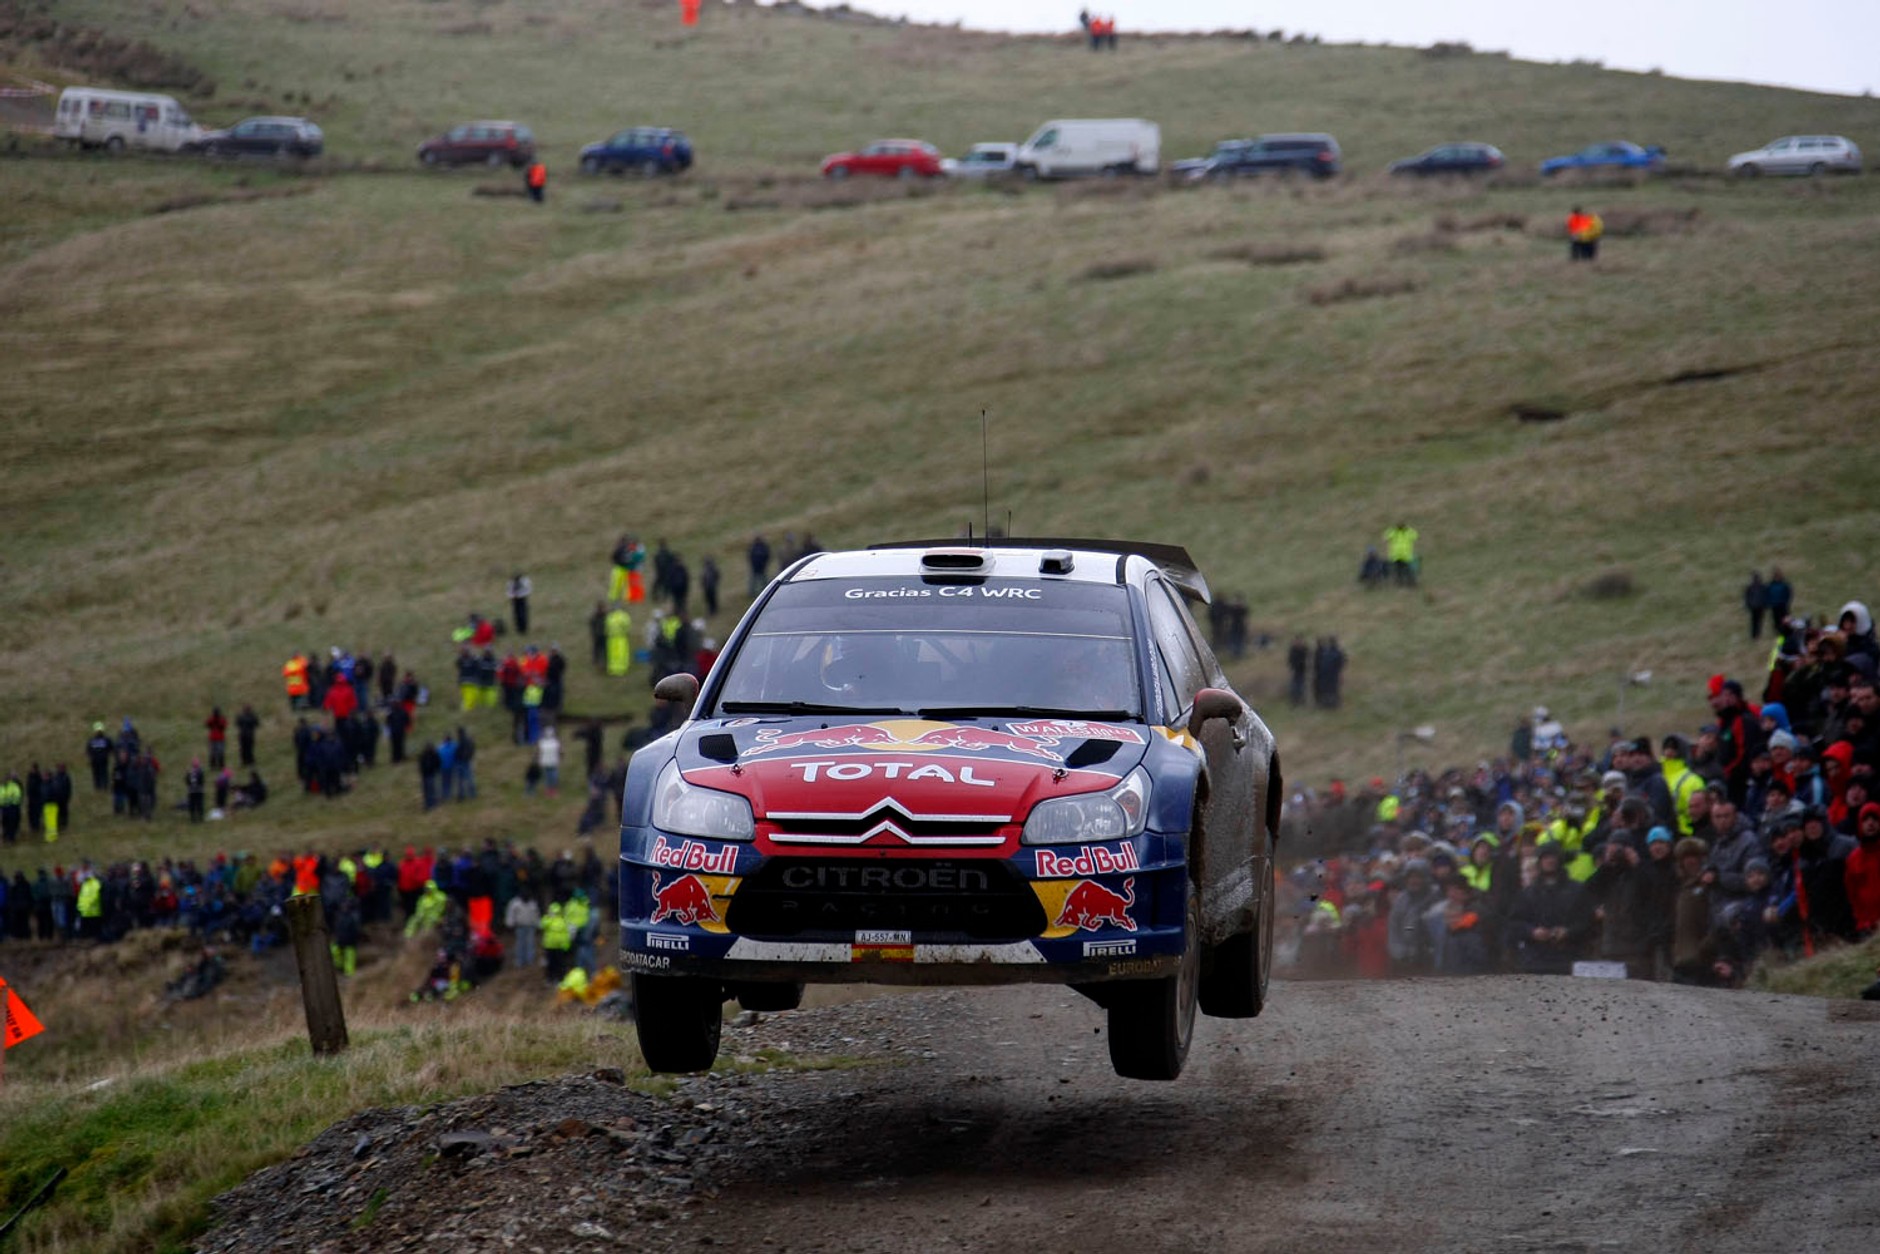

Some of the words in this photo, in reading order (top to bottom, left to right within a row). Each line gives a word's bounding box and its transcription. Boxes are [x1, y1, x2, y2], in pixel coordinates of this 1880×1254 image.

[844, 587, 931, 599] Gracias
[938, 586, 974, 597] C4
[980, 587, 1042, 599] WRC
[1016, 724, 1089, 736] WALES
[790, 761, 996, 787] TOTAL
[649, 835, 691, 868] Red
[684, 842, 740, 875] Bull
[1034, 846, 1096, 878] Red
[1091, 840, 1140, 874] Bull
[646, 931, 690, 951] PIRELLI
[1082, 938, 1137, 957] PIRELLI
